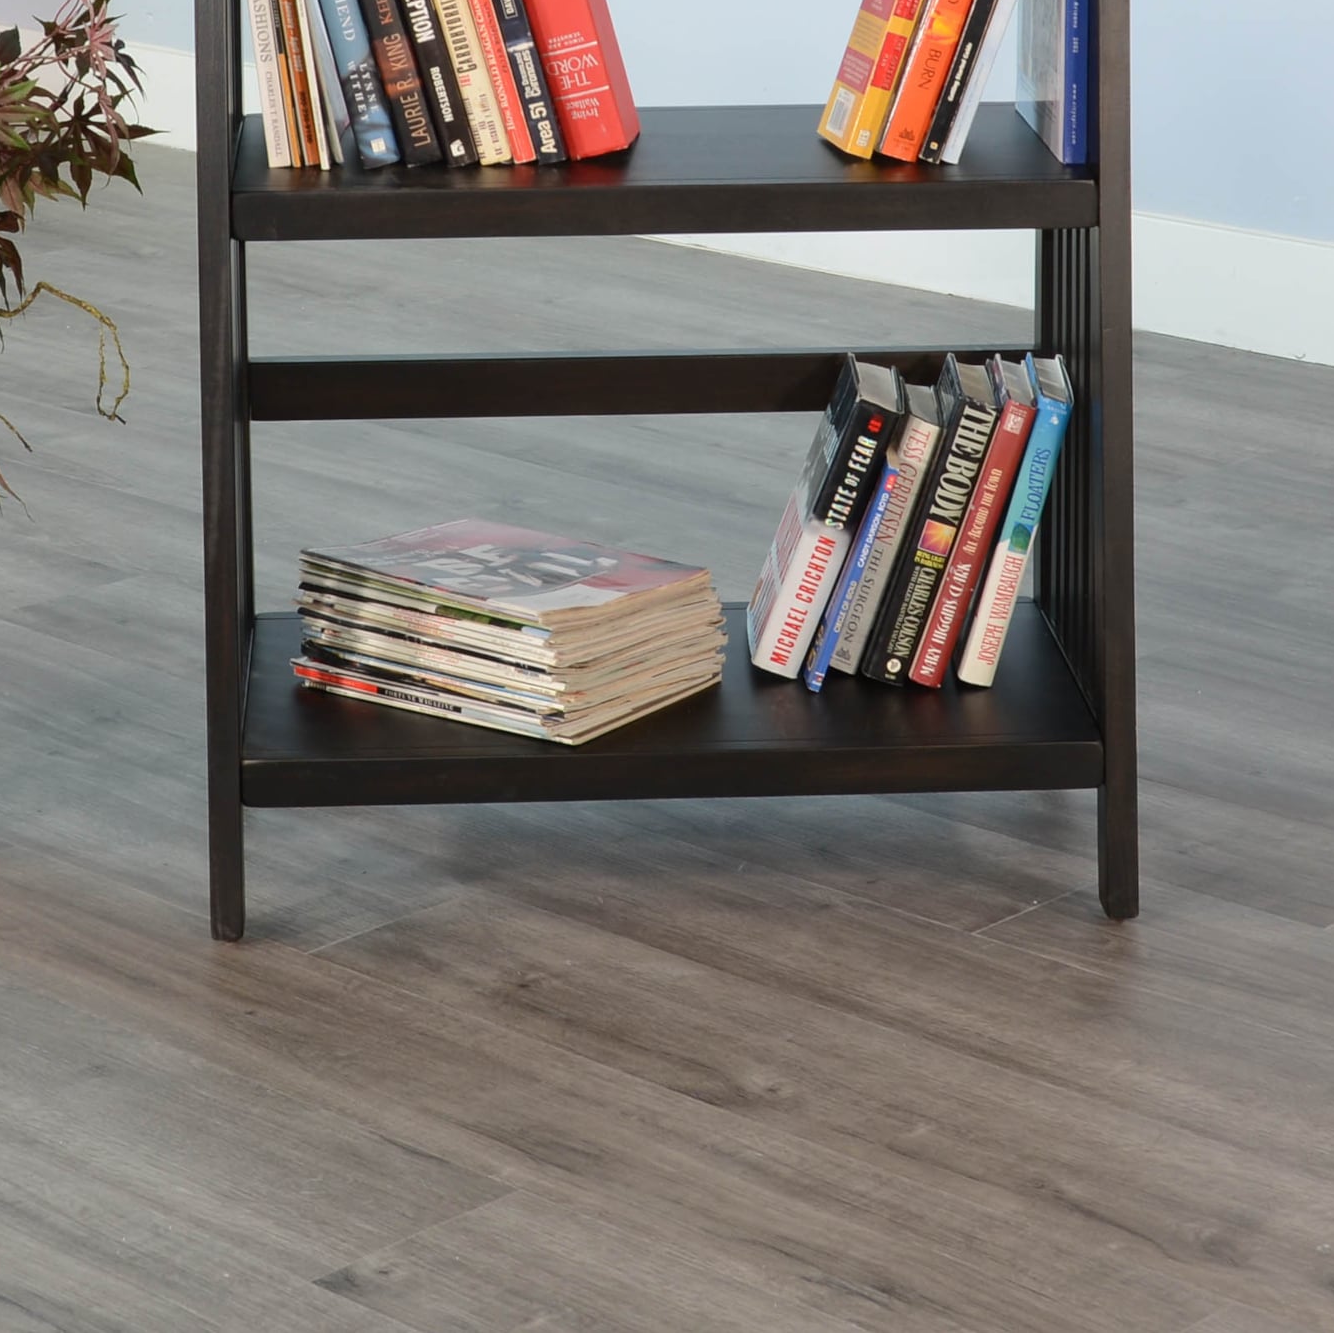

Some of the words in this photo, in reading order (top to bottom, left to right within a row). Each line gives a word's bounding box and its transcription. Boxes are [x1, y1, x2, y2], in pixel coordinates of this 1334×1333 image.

[382, 32, 409, 71] KING
[477, 23, 496, 64] REAGAN
[545, 51, 599, 76] WORD
[357, 62, 379, 113] LYNNE
[394, 72, 414, 90] R.
[490, 67, 508, 108] RONALD
[559, 70, 591, 90] THE
[916, 48, 941, 91] BURN
[946, 79, 961, 102] Getting
[345, 60, 370, 122] WITHEY
[428, 65, 454, 123] ROBERTSON
[529, 101, 547, 120] 51
[564, 95, 599, 110] Wallace
[263, 70, 276, 107] CHARLES
[270, 116, 282, 157] RANDALL
[398, 90, 431, 147] LAURIE
[570, 106, 598, 120] Irving
[534, 119, 558, 155] Area
[901, 426, 931, 462] TESS
[950, 403, 996, 460] THE
[847, 434, 878, 472] FEAR
[843, 472, 862, 487] OF
[927, 454, 979, 526] BODY
[1017, 445, 1055, 522] FLOATERS
[823, 486, 857, 531] STATE
[874, 461, 919, 546] GERRITSEN
[967, 505, 990, 540] AROUND
[984, 466, 1003, 491] TOWN
[856, 542, 871, 568] CANDY
[876, 492, 890, 512] BOYD
[866, 547, 884, 574] THE
[945, 559, 971, 598] CLARK
[769, 605, 808, 666] MICHAEL
[794, 535, 836, 604] CRICHTON
[841, 599, 851, 610] OF
[845, 579, 858, 600] GOLD
[906, 565, 938, 617] CHARLES
[988, 554, 1024, 622] WAMBAUGH
[833, 609, 847, 633] CIRCLE
[843, 576, 875, 643] SURGEON
[930, 597, 959, 645] HIGGINS
[892, 614, 922, 659] COLSON
[976, 621, 1004, 666] JOSEPH
[919, 644, 944, 678] MARY
